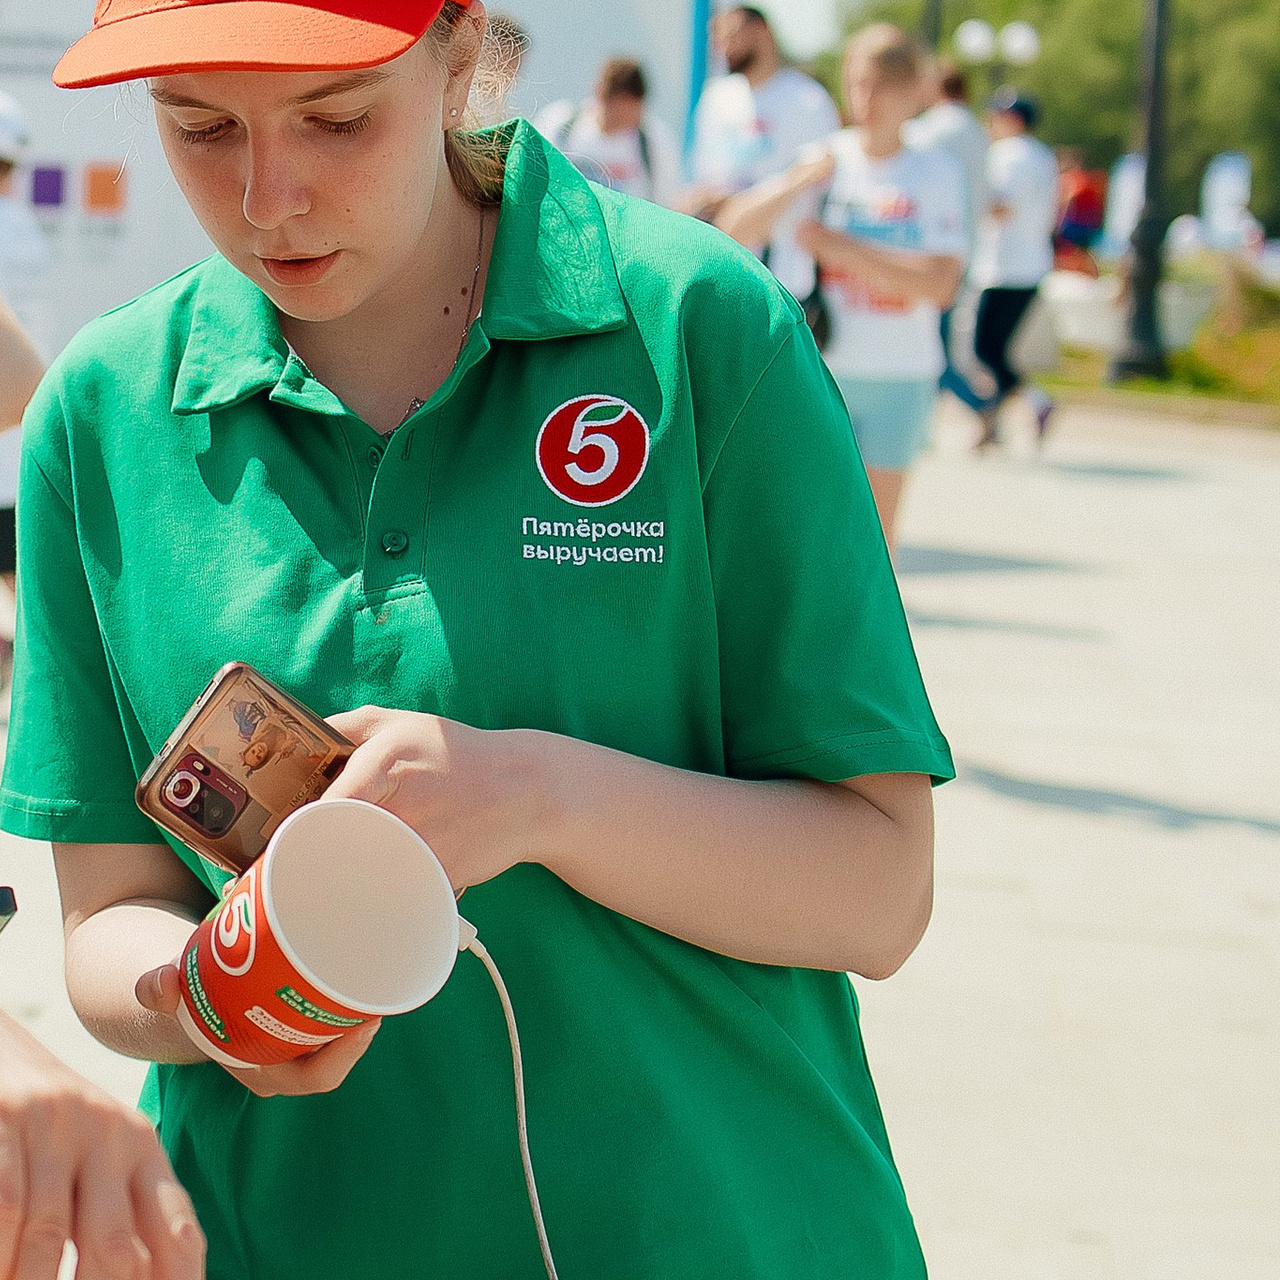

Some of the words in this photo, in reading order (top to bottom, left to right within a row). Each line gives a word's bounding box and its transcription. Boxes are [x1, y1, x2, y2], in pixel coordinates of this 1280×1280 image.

[564, 401, 628, 486] 5
[522, 516, 664, 542] Пятёрочка
[522, 544, 664, 566] выручает!
[192, 967, 221, 1025] сладким
